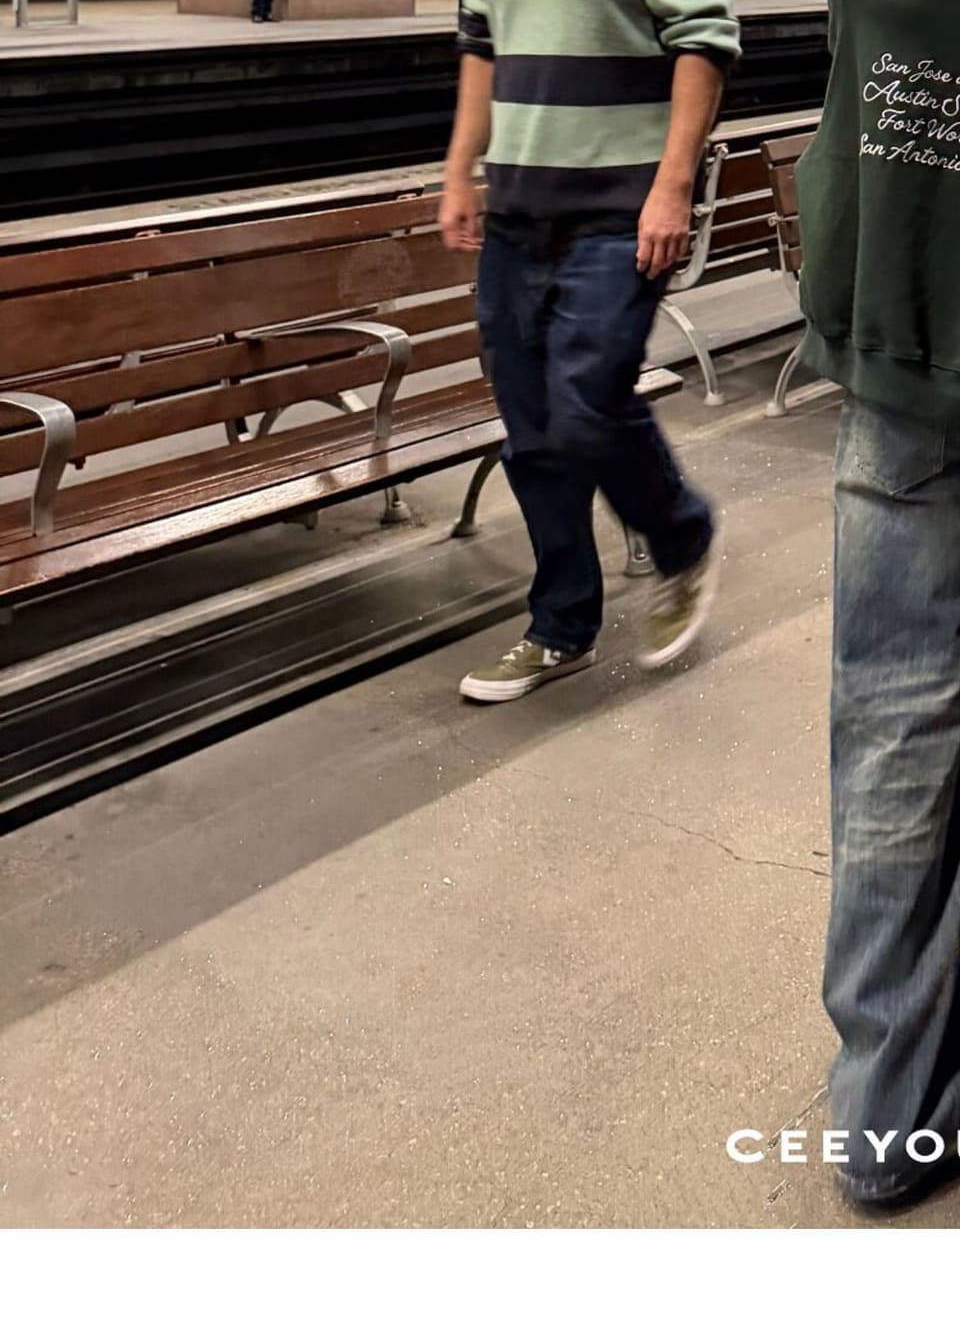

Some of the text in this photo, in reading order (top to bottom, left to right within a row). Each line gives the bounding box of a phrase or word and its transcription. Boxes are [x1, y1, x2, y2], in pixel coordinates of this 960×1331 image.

[872, 52, 911, 75] San
[908, 59, 952, 83] Jose
[863, 79, 941, 110] Austin
[877, 108, 926, 135] Fort
